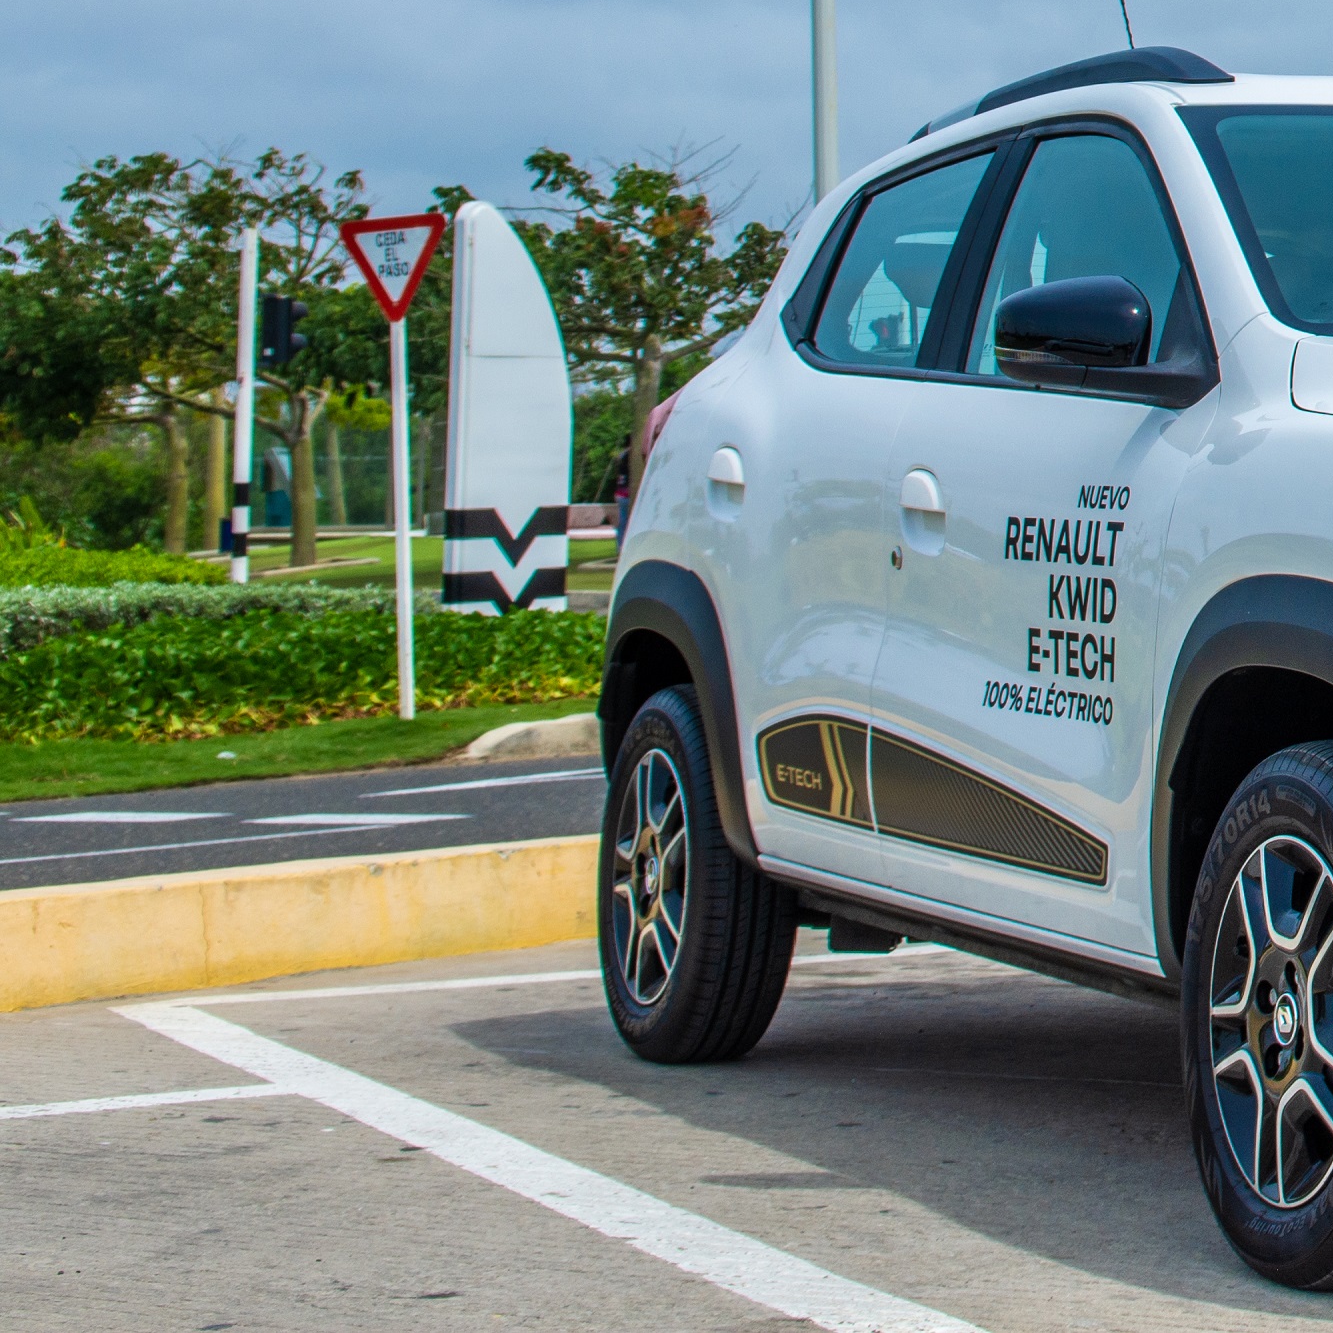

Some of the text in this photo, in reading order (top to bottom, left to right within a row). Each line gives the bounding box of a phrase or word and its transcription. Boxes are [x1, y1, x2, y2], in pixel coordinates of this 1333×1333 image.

[375, 231, 405, 247] CEDA
[385, 248, 398, 262] EL
[378, 262, 408, 278] PASO
[1078, 485, 1131, 510] NUEVO
[1004, 516, 1125, 567] RENAULT
[1048, 574, 1117, 624] KWID
[1027, 627, 1116, 683] E-TECH
[982, 680, 1114, 725] 100% ELÉCTRICO
[776, 764, 821, 791] E-TECH
